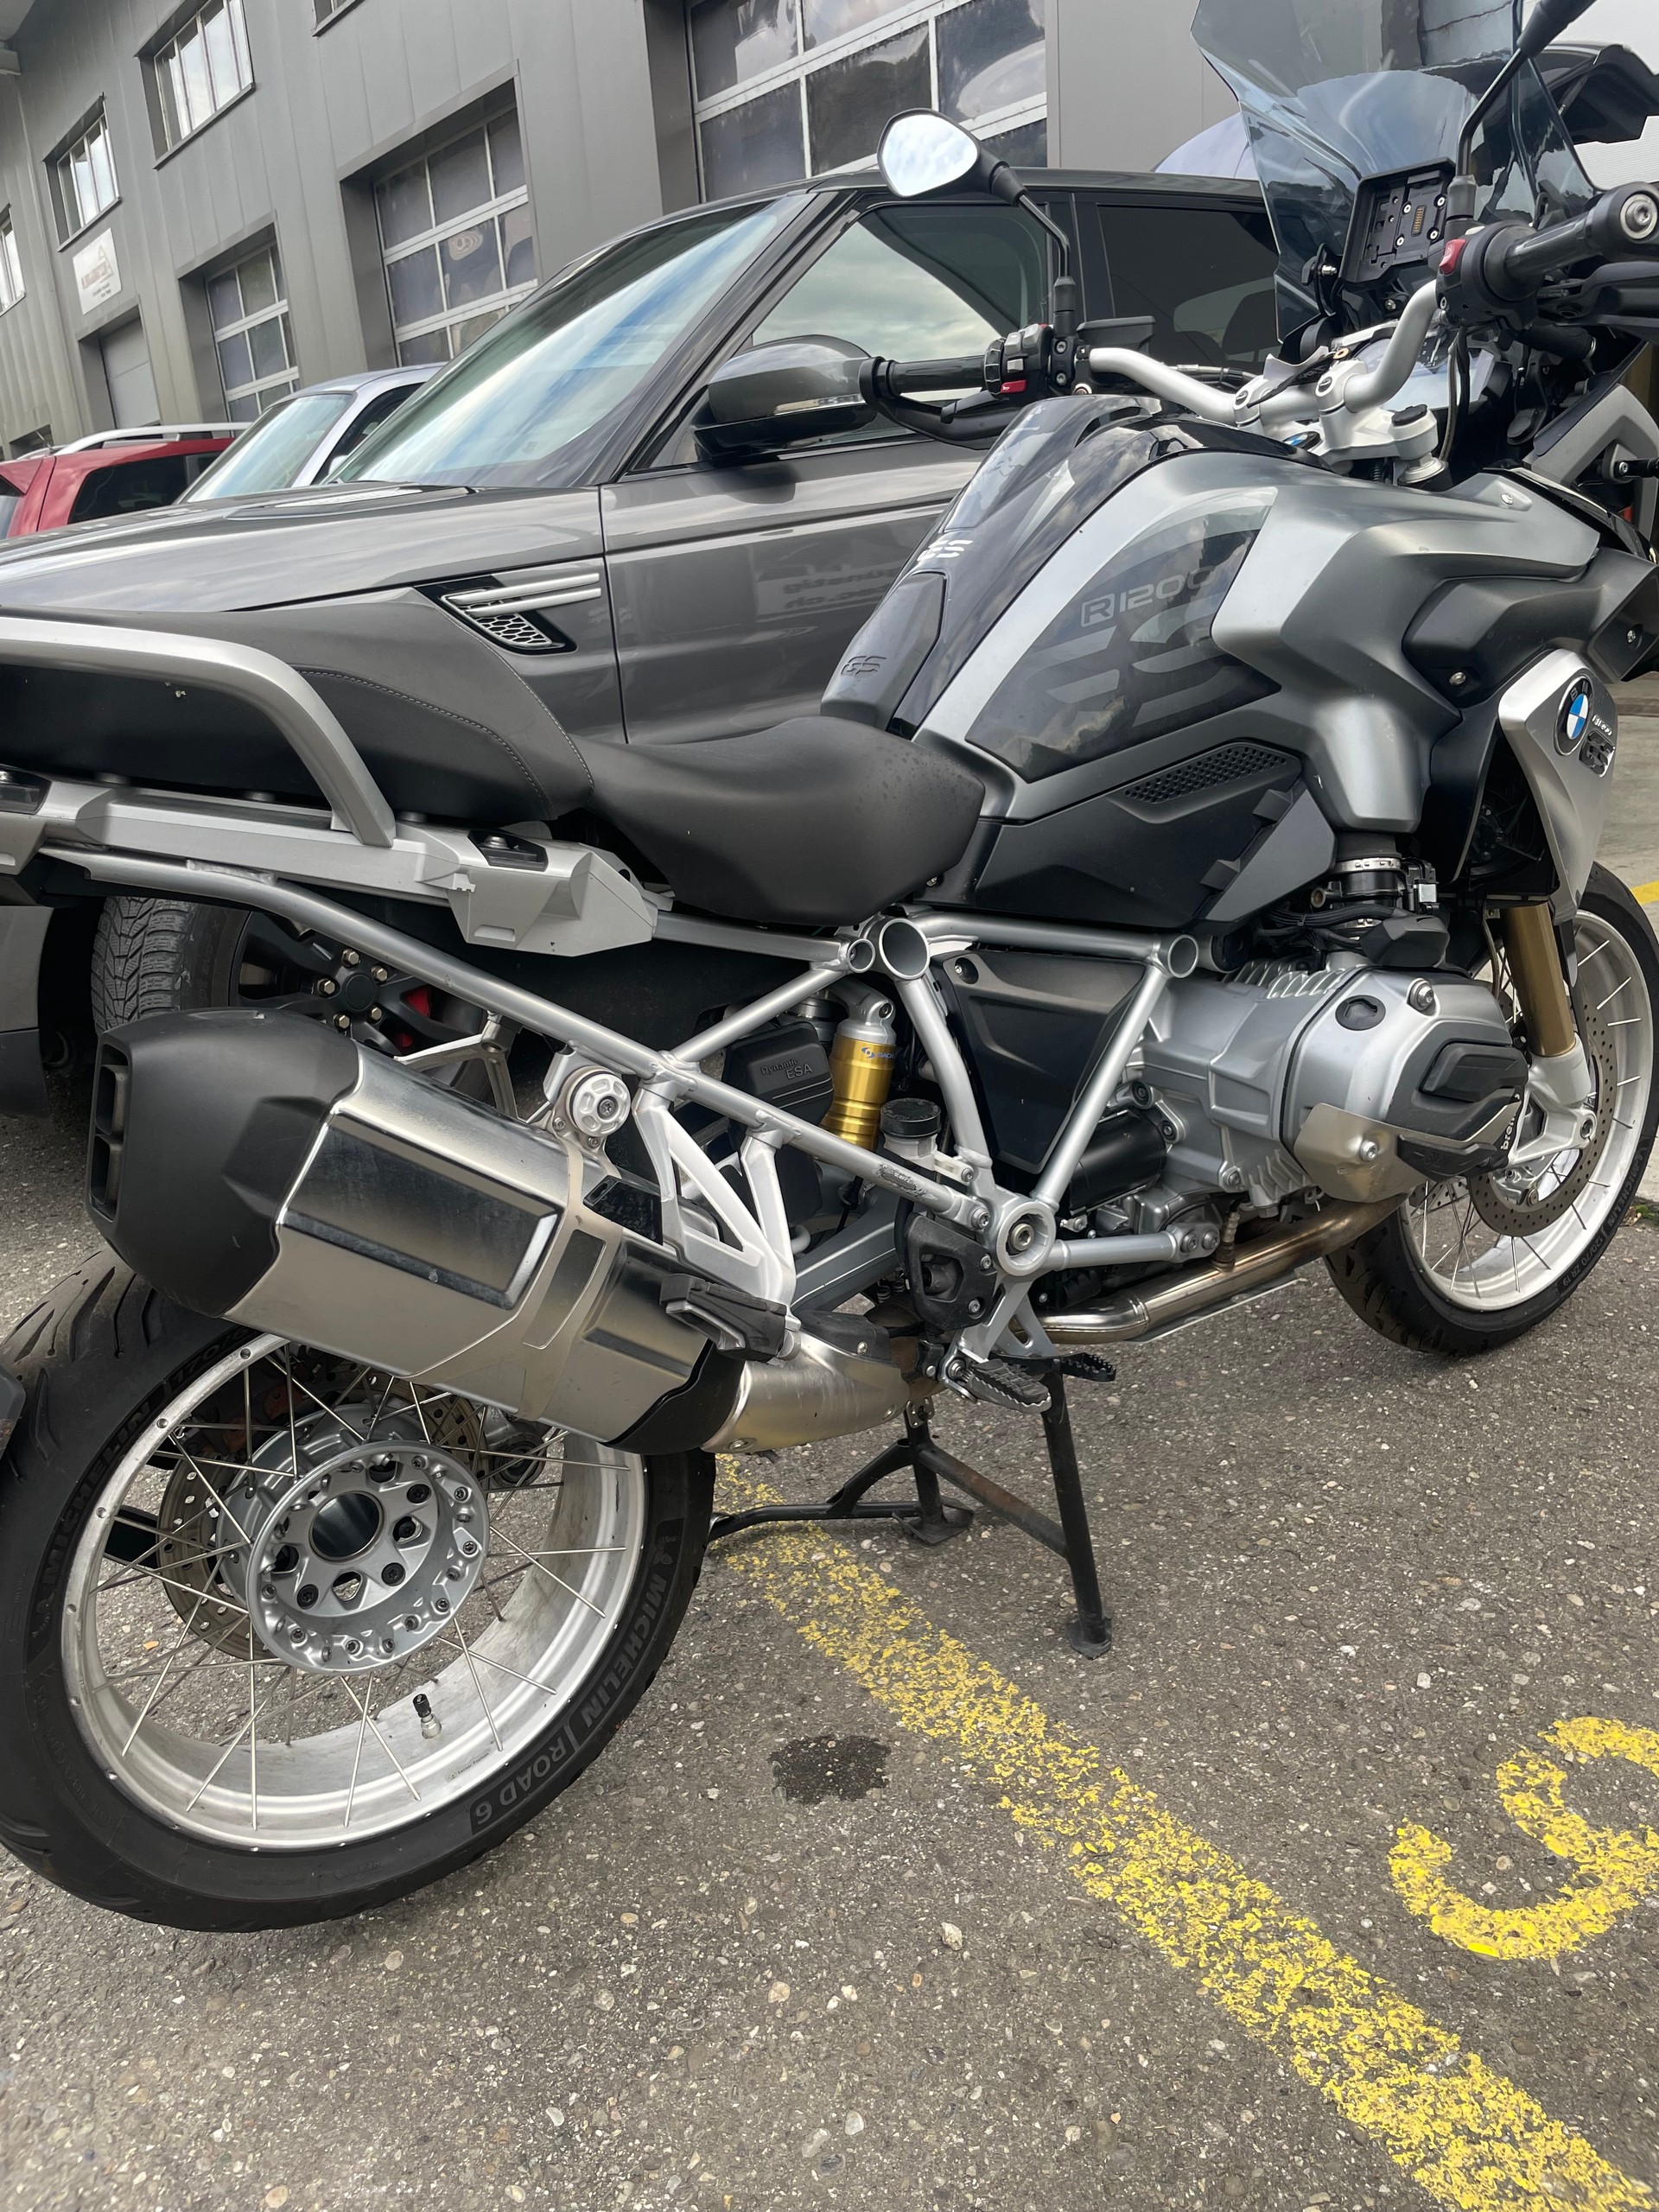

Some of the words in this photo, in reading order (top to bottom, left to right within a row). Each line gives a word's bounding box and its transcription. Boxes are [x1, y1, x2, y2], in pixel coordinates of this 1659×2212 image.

[761, 1058, 800, 1076] Dynamic
[785, 1063, 813, 1080] ESA
[43, 1402, 150, 1580] MICHELIN
[580, 1573, 667, 1726] MICHELIN
[499, 1736, 570, 1806] ROAD
[475, 1805, 493, 1826] 6
